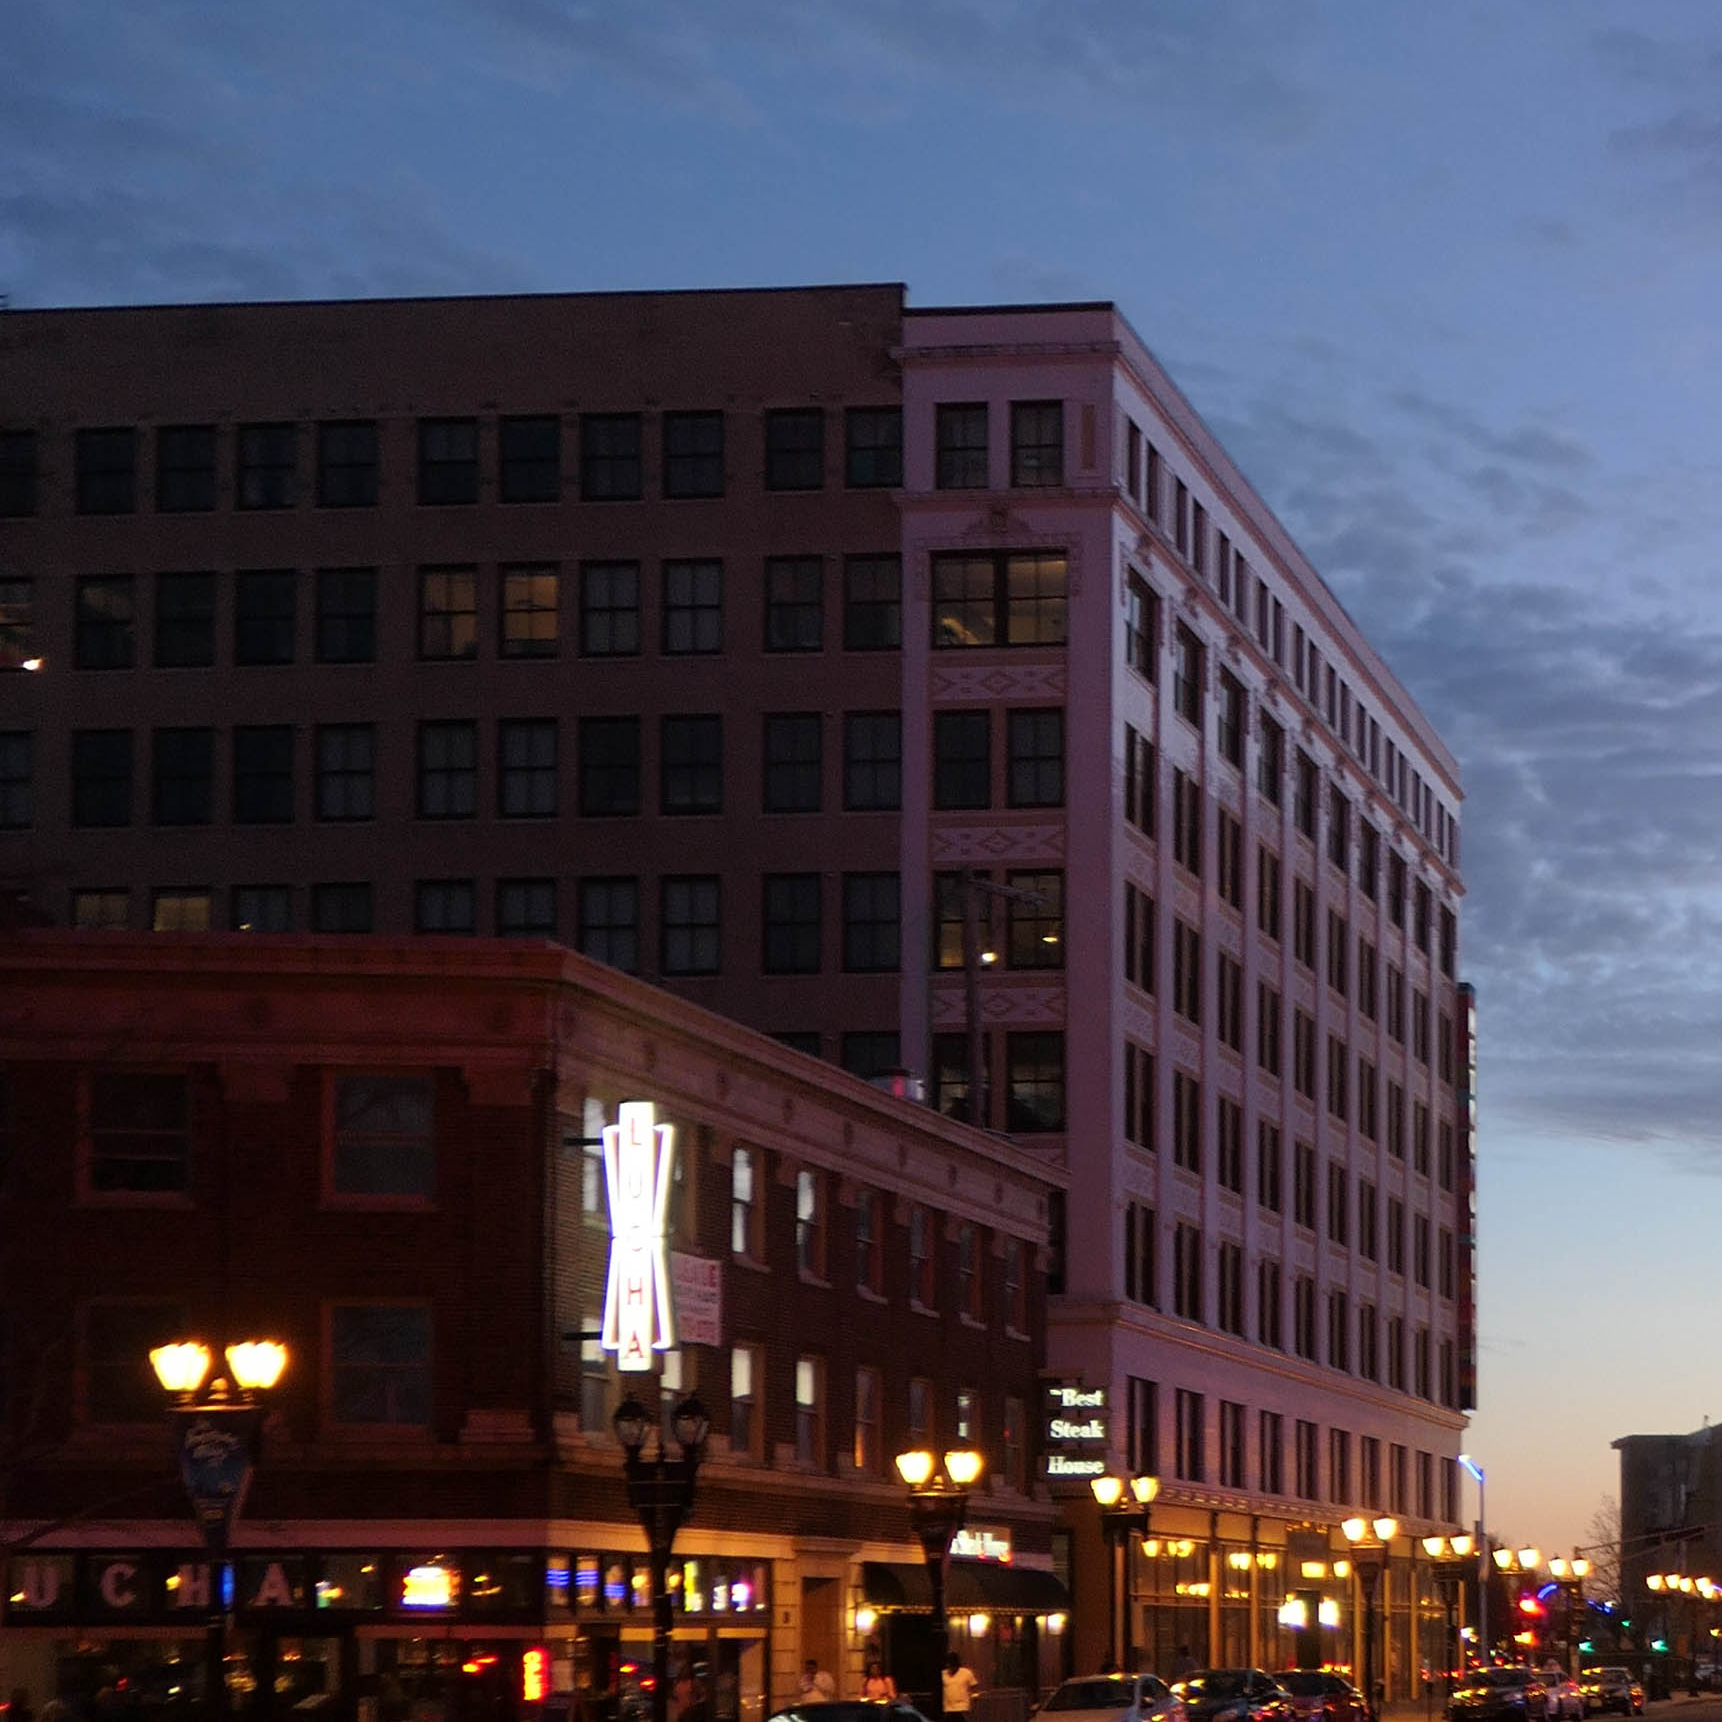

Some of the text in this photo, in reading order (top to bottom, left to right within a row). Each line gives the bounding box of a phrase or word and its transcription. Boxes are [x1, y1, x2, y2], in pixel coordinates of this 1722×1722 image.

[625, 1116, 644, 1360] LUCHA
[1061, 1388, 1104, 1407] Best
[1050, 1419, 1105, 1439] Steak
[1047, 1455, 1105, 1474] House
